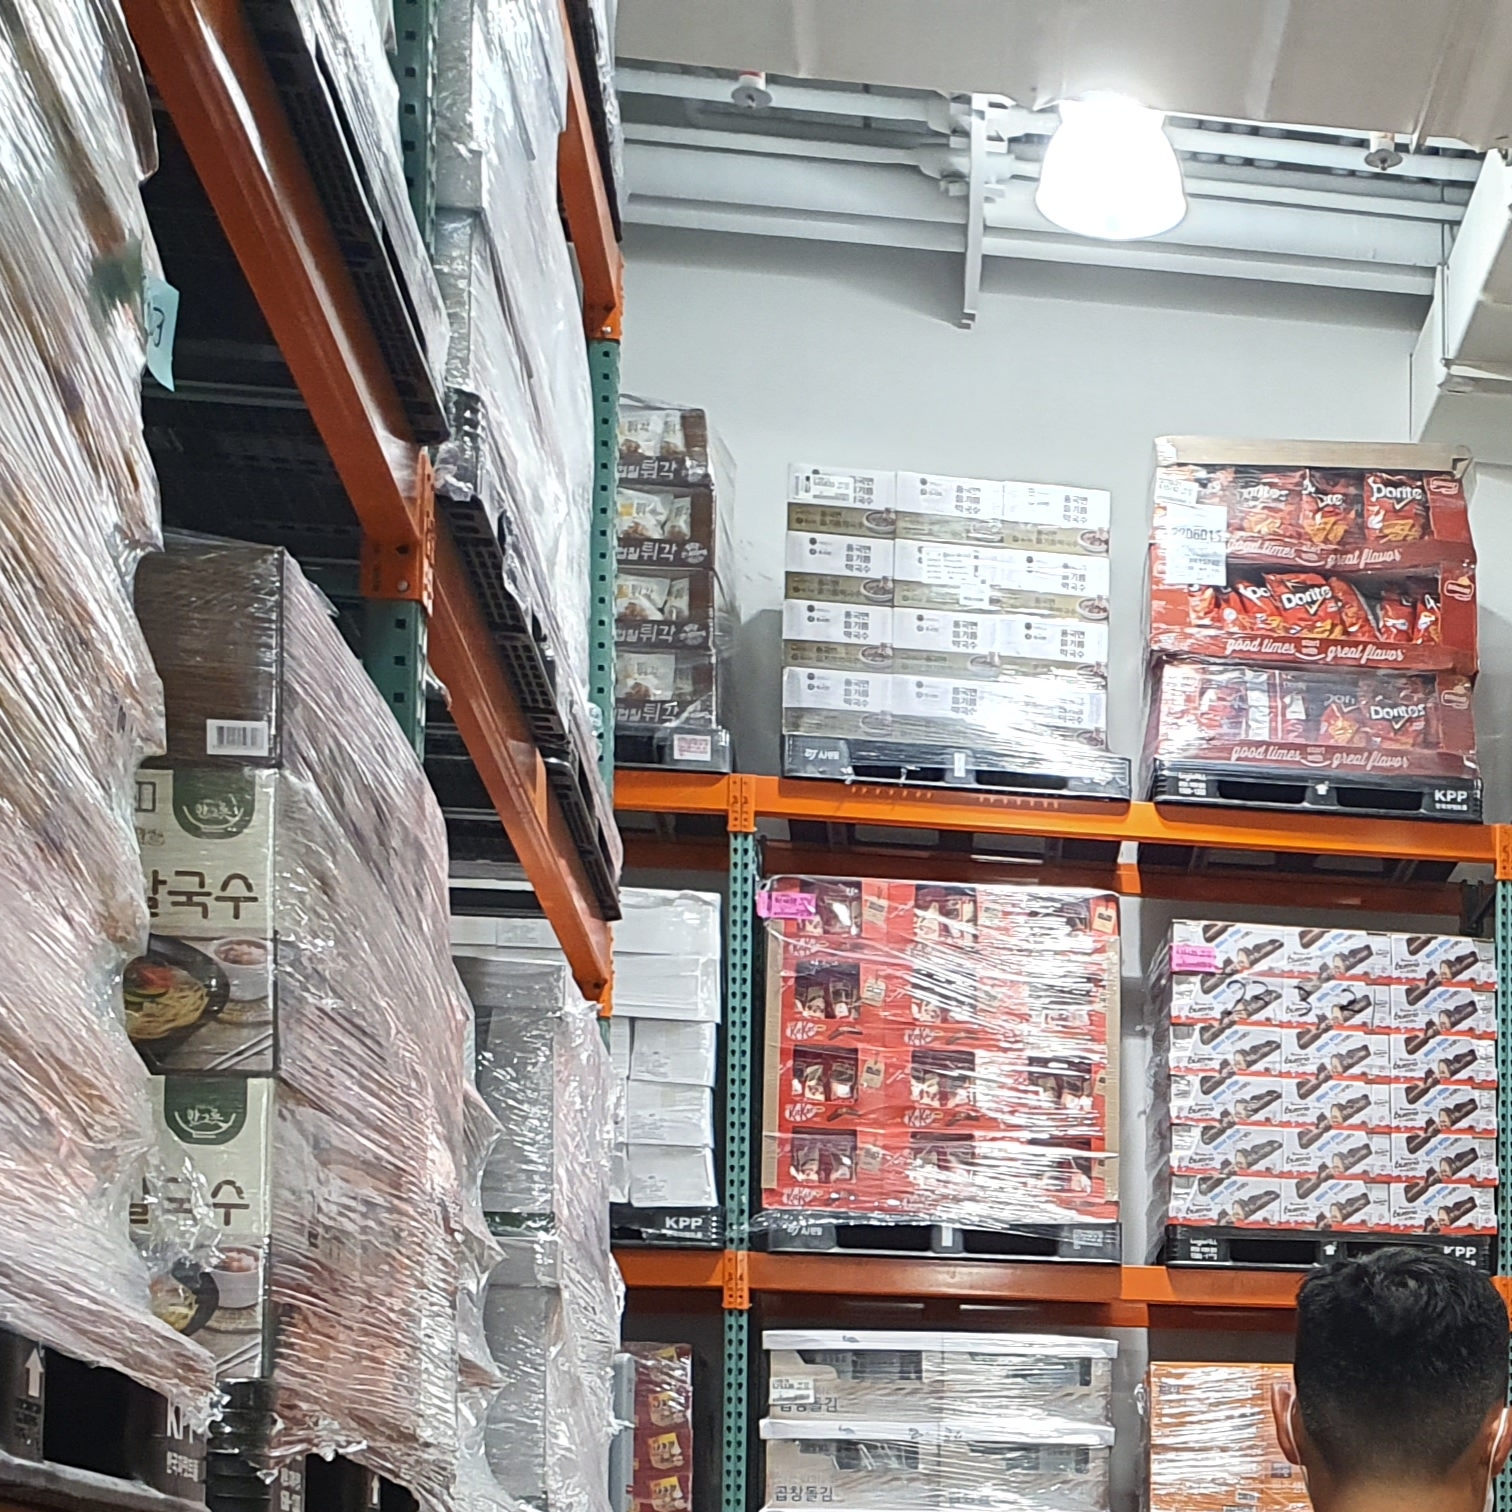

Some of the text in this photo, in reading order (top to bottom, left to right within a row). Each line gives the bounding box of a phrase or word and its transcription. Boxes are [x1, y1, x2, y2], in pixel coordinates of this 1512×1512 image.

[1227, 638, 1405, 663] good times great flavor
[1232, 745, 1410, 769] good times great flavor
[1435, 790, 1467, 802] KPP
[665, 1217, 703, 1229] KPP
